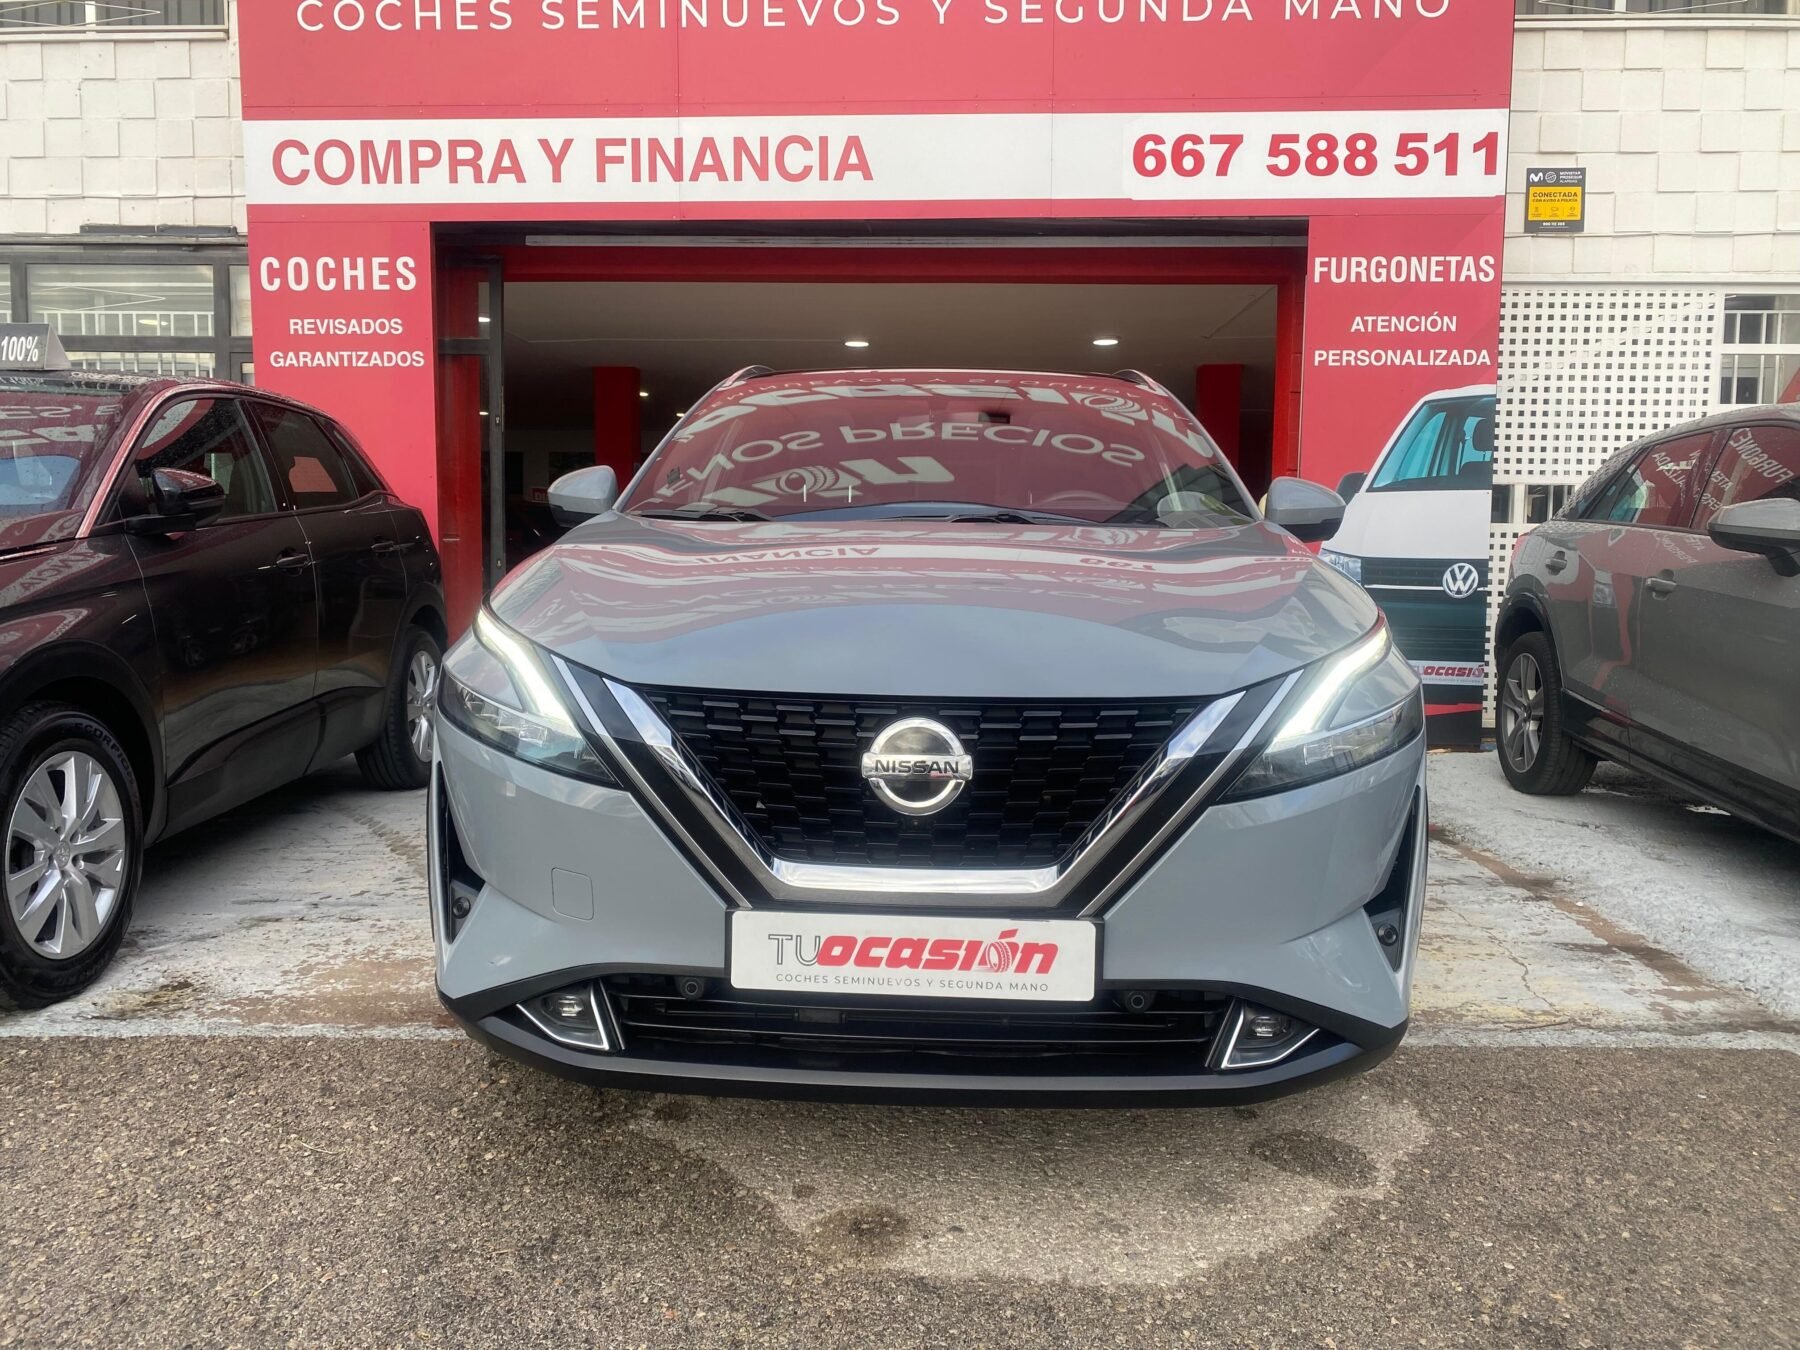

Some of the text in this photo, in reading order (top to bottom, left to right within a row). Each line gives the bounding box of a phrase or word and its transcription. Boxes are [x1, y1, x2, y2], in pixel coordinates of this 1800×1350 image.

[296, 0, 1450, 32] COCHES SEMINUEVOS Y SEGUNDA MANO
[272, 135, 874, 186] COMPRA Y FINANCIA
[1132, 131, 1499, 178] 667 588 511
[1532, 191, 1578, 199] CONECTADA
[260, 256, 417, 292] COCHES
[1313, 255, 1496, 284] FURGONETAS
[289, 318, 404, 335] REVISADOS
[1350, 311, 1458, 333] ATENCIÓN
[1, 335, 39, 362] 100%
[269, 350, 425, 368] GARANTIZADOS
[1313, 349, 1492, 367] PERSONALIZADA
[874, 759, 959, 774] NISSAN
[775, 973, 1050, 992] COCHES SEMINUEVOS Y SEGUNDA MANO
